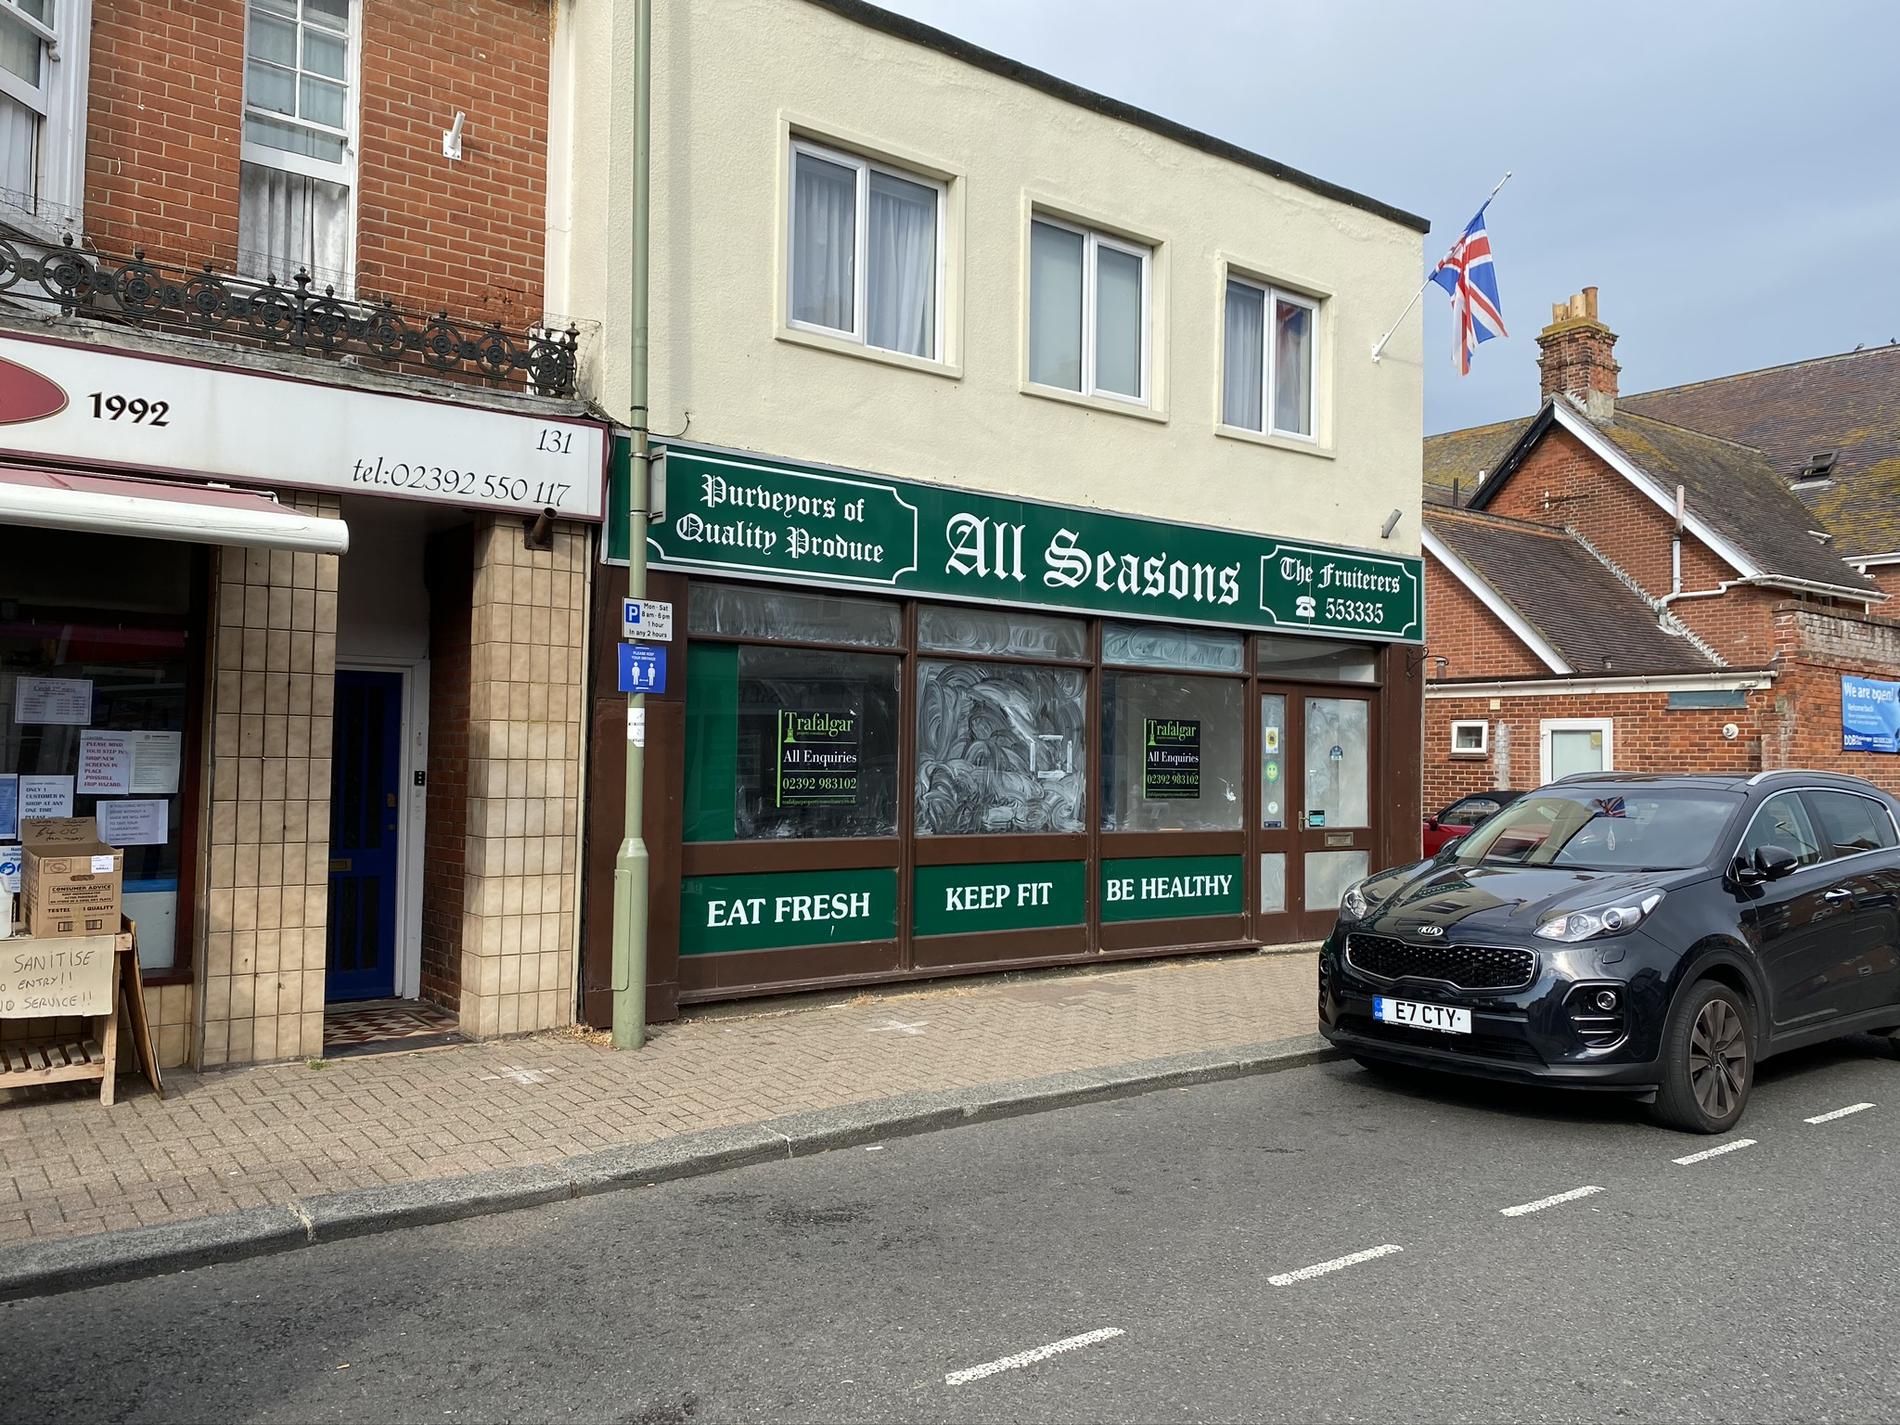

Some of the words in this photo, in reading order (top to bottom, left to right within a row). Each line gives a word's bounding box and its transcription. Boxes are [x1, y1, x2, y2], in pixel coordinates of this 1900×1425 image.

[88, 391, 170, 427] 1992
[536, 429, 572, 454] 131
[352, 457, 476, 495] tel:02392
[480, 474, 528, 500] 550
[533, 481, 571, 507] 117
[700, 473, 836, 521] Purveyors
[844, 498, 866, 523] of
[676, 512, 777, 555] Quality
[785, 526, 884, 564] Produce
[945, 512, 1027, 582] All
[1043, 527, 1241, 606] Seasons
[1280, 556, 1313, 586] The
[1317, 563, 1400, 593] Fruiterers
[629, 605, 638, 622] P
[643, 602, 656, 610] Mon
[659, 604, 669, 612] Sat
[1325, 598, 1384, 624] 553335
[653, 630, 667, 638] hours
[1844, 682, 1857, 698] We
[1857, 687, 1870, 699] are
[1872, 688, 1894, 704] open!
[785, 712, 854, 737] Trafalgar
[1147, 720, 1197, 741] Trafalgar
[783, 750, 800, 763] All
[804, 750, 857, 767] Enquiries
[1147, 751, 1159, 762] All
[1161, 751, 1199, 766] Enquiries
[783, 778, 816, 790] 02392
[819, 778, 857, 790] 983102
[1147, 774, 1170, 785] 02392
[1171, 774, 1199, 785] 983102
[945, 884, 1011, 911] KEEP
[1017, 882, 1053, 906] FIT
[1107, 878, 1134, 901] BE
[1141, 874, 1232, 900] HEALTHY
[707, 898, 766, 927] EAT
[774, 892, 870, 923] FRESH
[1420, 926, 1438, 934] KIA
[13, 948, 95, 974] SANITISE
[1396, 1002, 1417, 1021] E7
[1422, 1005, 1456, 1028] CTY
